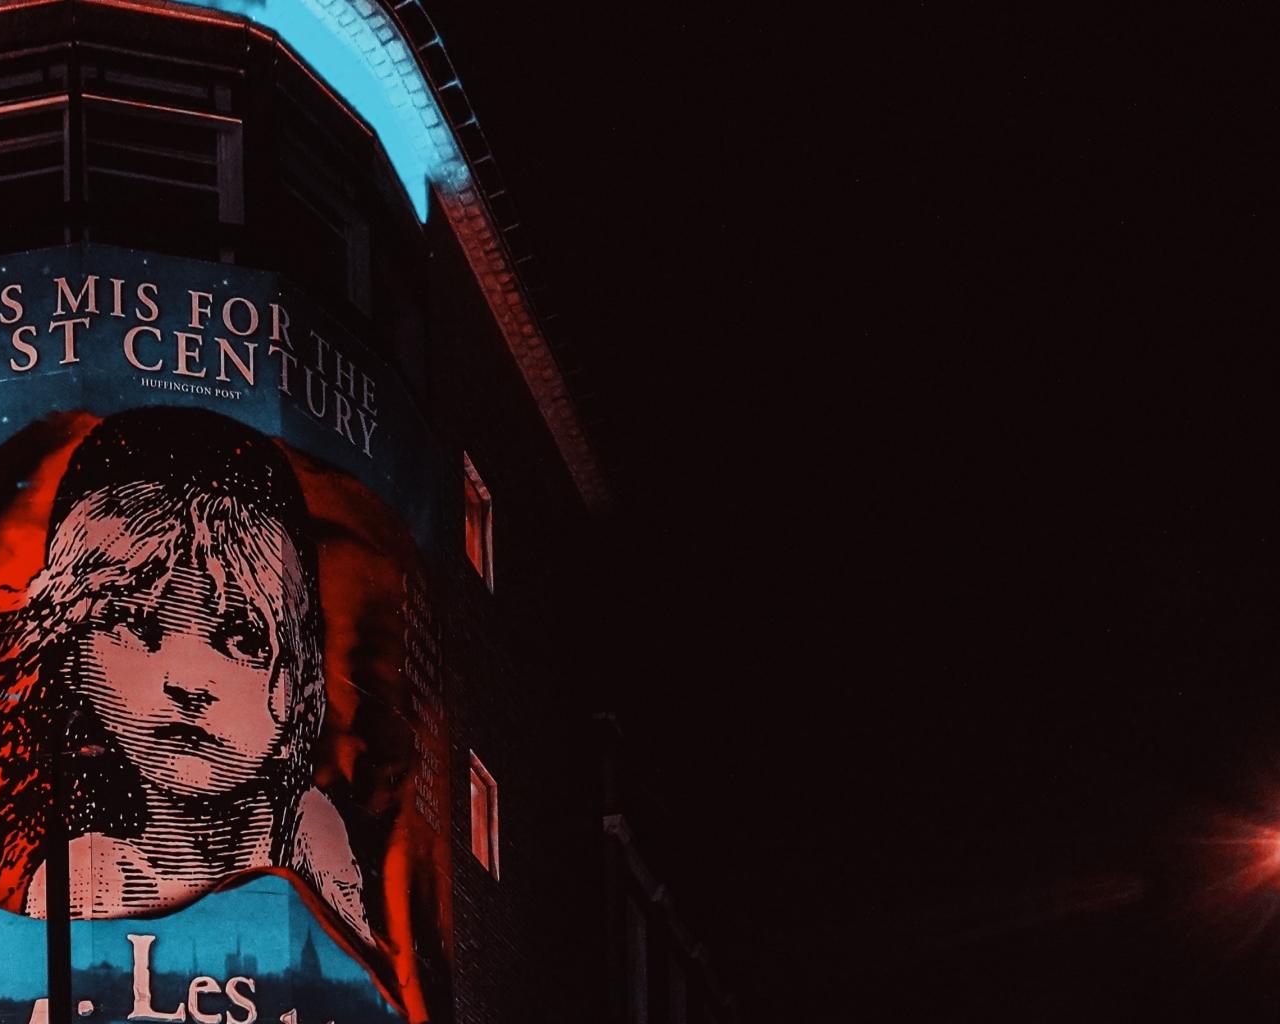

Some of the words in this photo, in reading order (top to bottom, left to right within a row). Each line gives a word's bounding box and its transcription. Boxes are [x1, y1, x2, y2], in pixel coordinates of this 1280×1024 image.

[54, 274, 159, 323] MIS
[189, 289, 294, 352] FOR
[310, 330, 379, 418] THE
[123, 325, 380, 460] CENTURY
[140, 377, 212, 397] HUFFINGTON
[215, 387, 242, 401] POST
